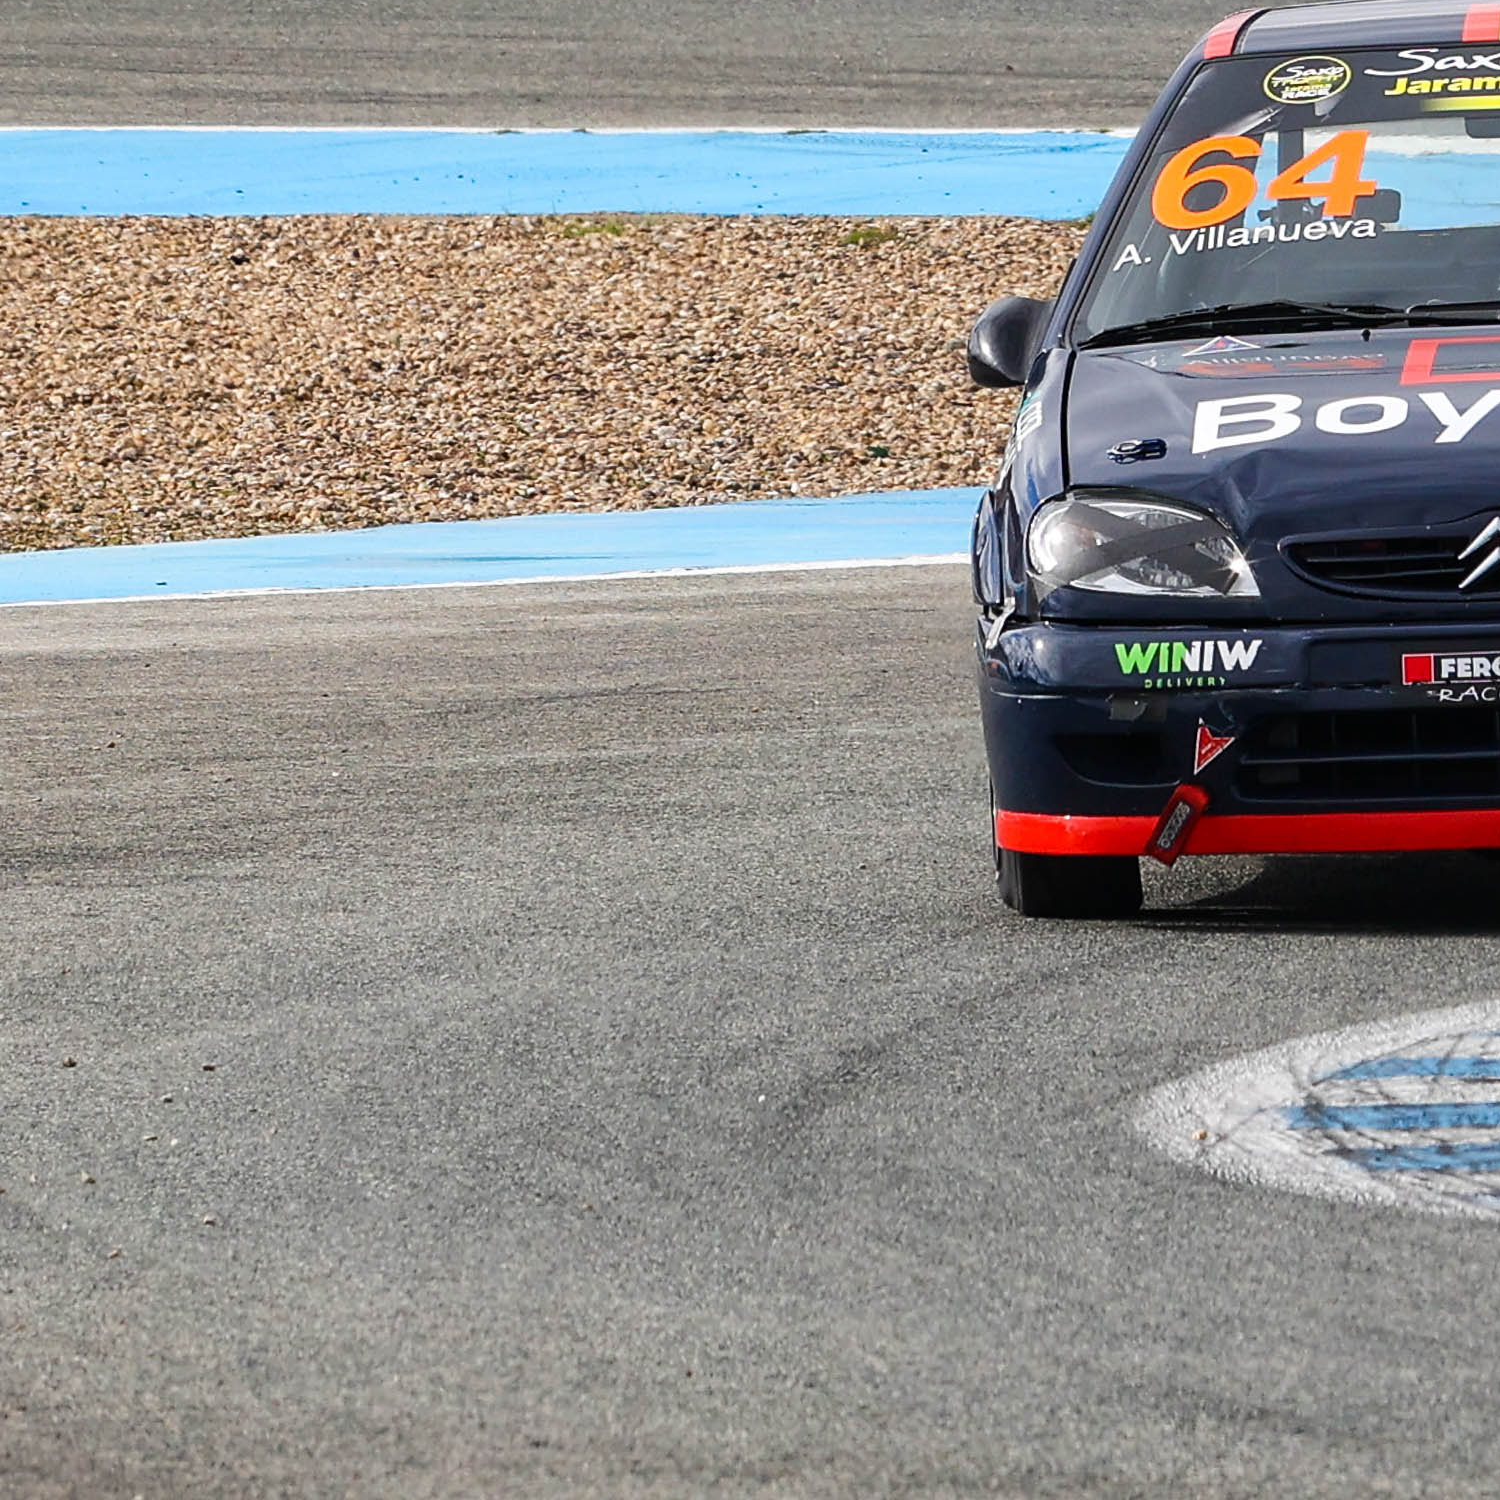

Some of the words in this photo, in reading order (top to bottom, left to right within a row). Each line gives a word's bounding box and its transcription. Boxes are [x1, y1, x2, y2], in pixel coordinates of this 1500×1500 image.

[1272, 65, 1344, 80] Saxo
[1152, 130, 1378, 230] 64
[1113, 244, 1152, 272] A.
[1169, 218, 1376, 255] Villanueva
[1115, 640, 1263, 674] WINIW
[1144, 677, 1226, 689] DELIVERY
